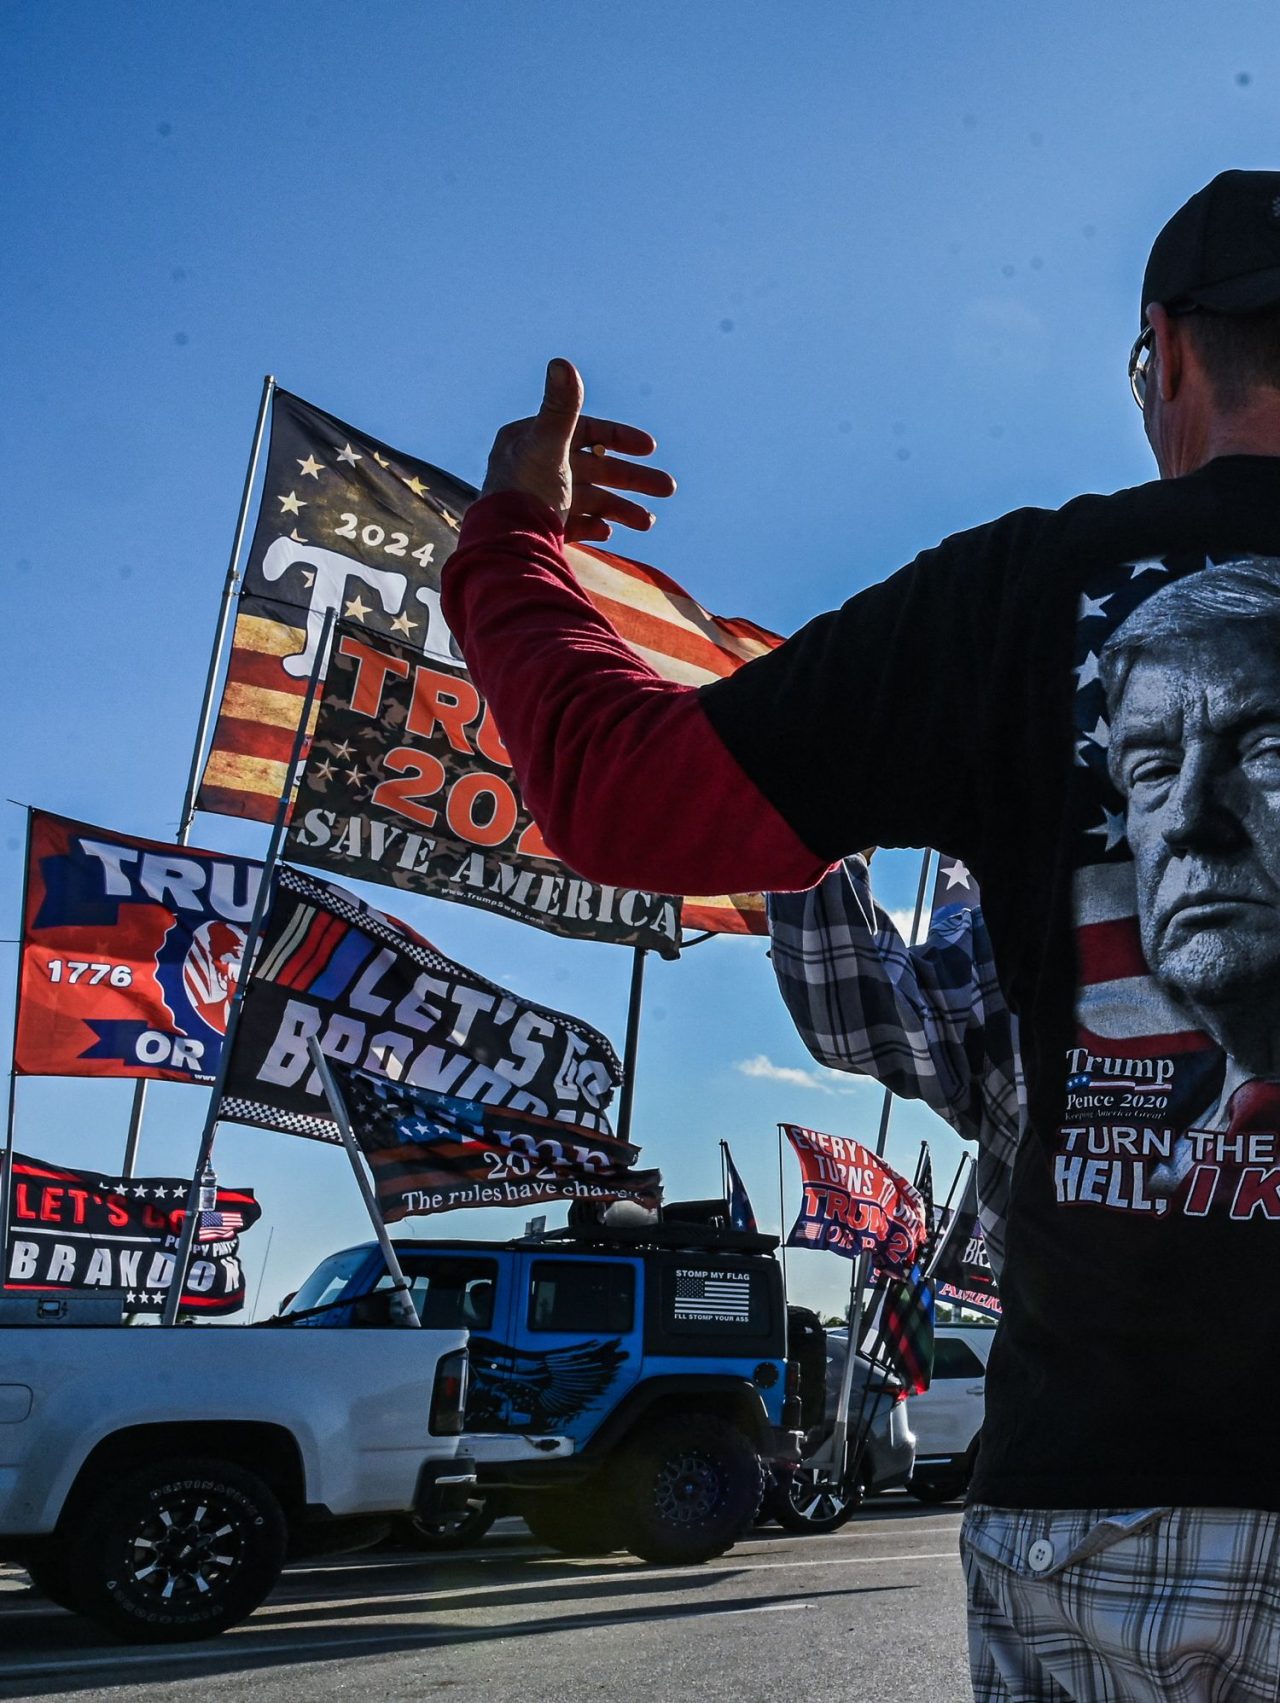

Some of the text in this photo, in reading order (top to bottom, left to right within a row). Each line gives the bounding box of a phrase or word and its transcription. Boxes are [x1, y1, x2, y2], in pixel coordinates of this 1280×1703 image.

[335, 512, 435, 568] 2024
[296, 808, 677, 942] SAVE AMERICA
[47, 959, 133, 988] 1776
[350, 947, 555, 1088] LET'S
[135, 1030, 205, 1071] OR
[1065, 1048, 1175, 1086] Trump
[1066, 1093, 1168, 1111] Pence 2020
[1060, 1125, 1172, 1157] TURN
[1187, 1131, 1275, 1163] THE
[402, 1185, 443, 1211] The
[448, 1179, 501, 1206] rules
[504, 1176, 557, 1202] have
[814, 1154, 874, 1196] TURNS
[1054, 1154, 1168, 1215] HELL,
[1183, 1165, 1221, 1217] I
[16, 1183, 129, 1227] LET'S
[8, 1240, 240, 1293] BRANDON
[675, 1269, 708, 1279] STOMP
[727, 1273, 750, 1281] FLAG
